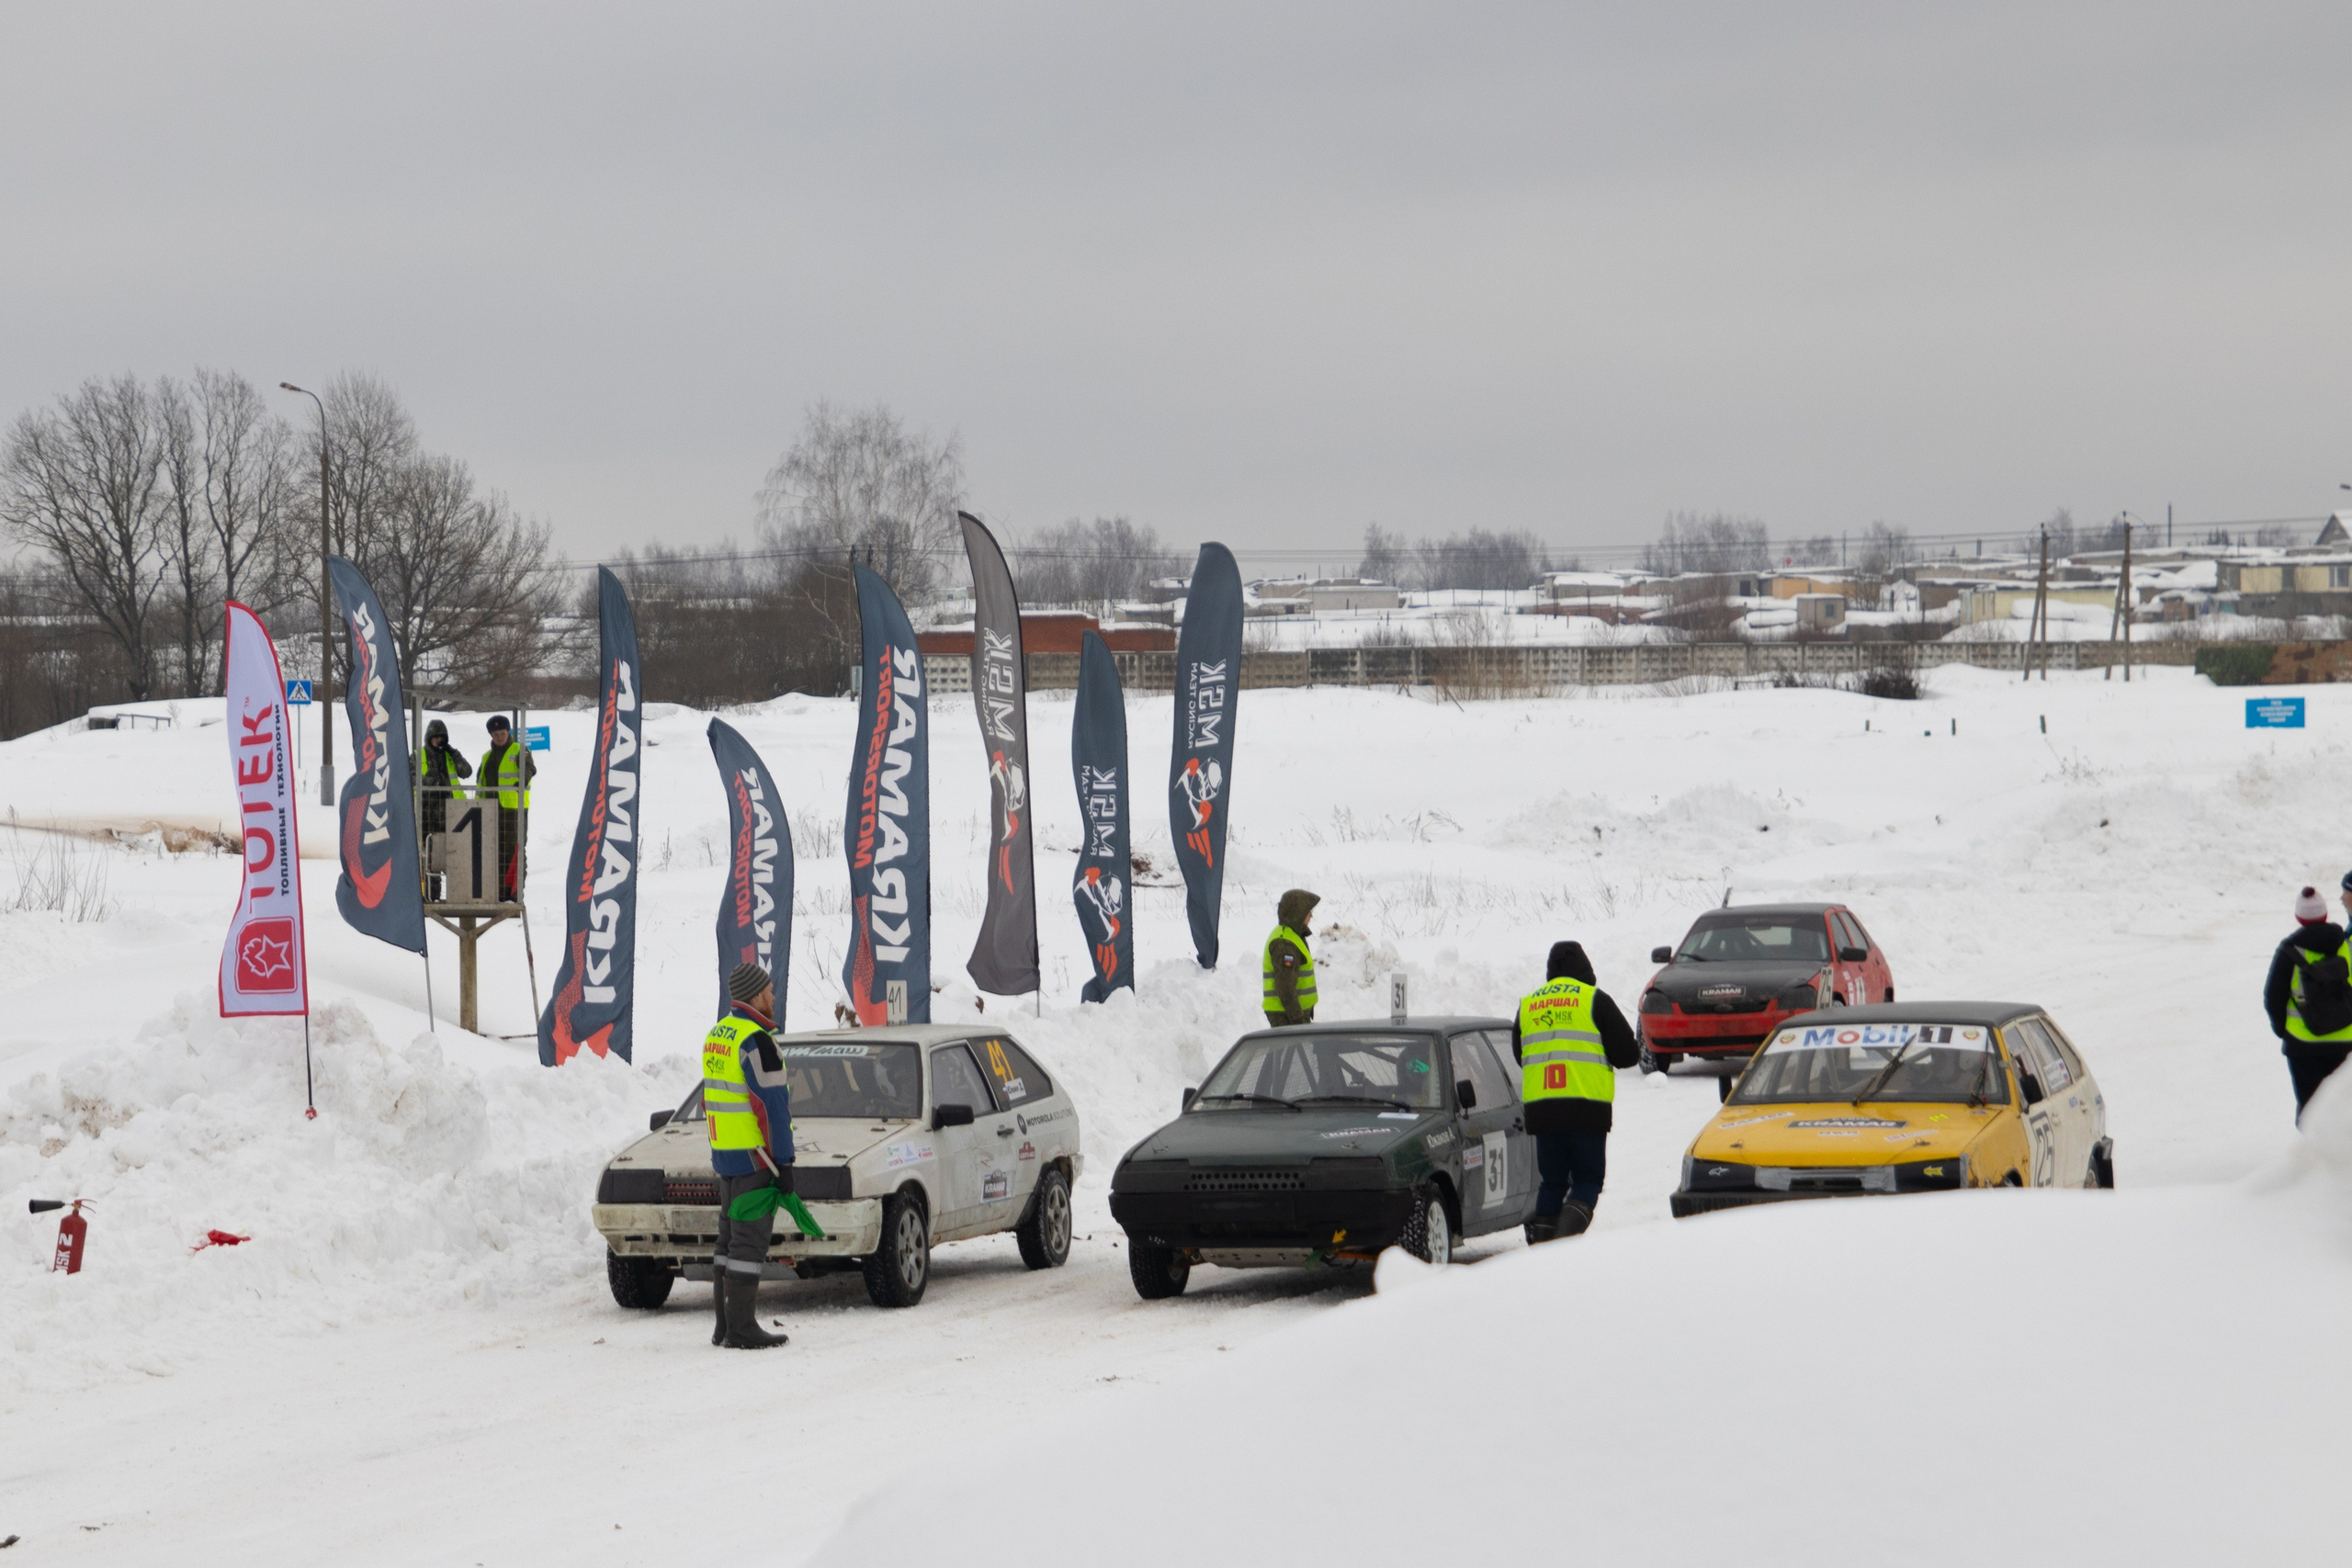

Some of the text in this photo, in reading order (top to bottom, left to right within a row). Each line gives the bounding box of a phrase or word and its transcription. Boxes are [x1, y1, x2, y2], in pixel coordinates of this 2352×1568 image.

[275, 704, 289, 897] ТОПЛИВНЫЕ ТЕХНОЛОГИИ
[452, 807, 482, 898] 1
[888, 986, 901, 1014] 41
[1395, 983, 1405, 1009] 31
[1702, 987, 1742, 997] KRAMAR
[1529, 998, 1579, 1013] МАРШАЛ
[1555, 1010, 1573, 1021] MSK
[1803, 1024, 1909, 1046] Mobil
[1025, 1114, 1054, 1127] MOTOROLA
[1797, 1120, 1897, 1128] KRAMAR
[1488, 1146, 1504, 1192] 31
[59, 1232, 74, 1247] 2
